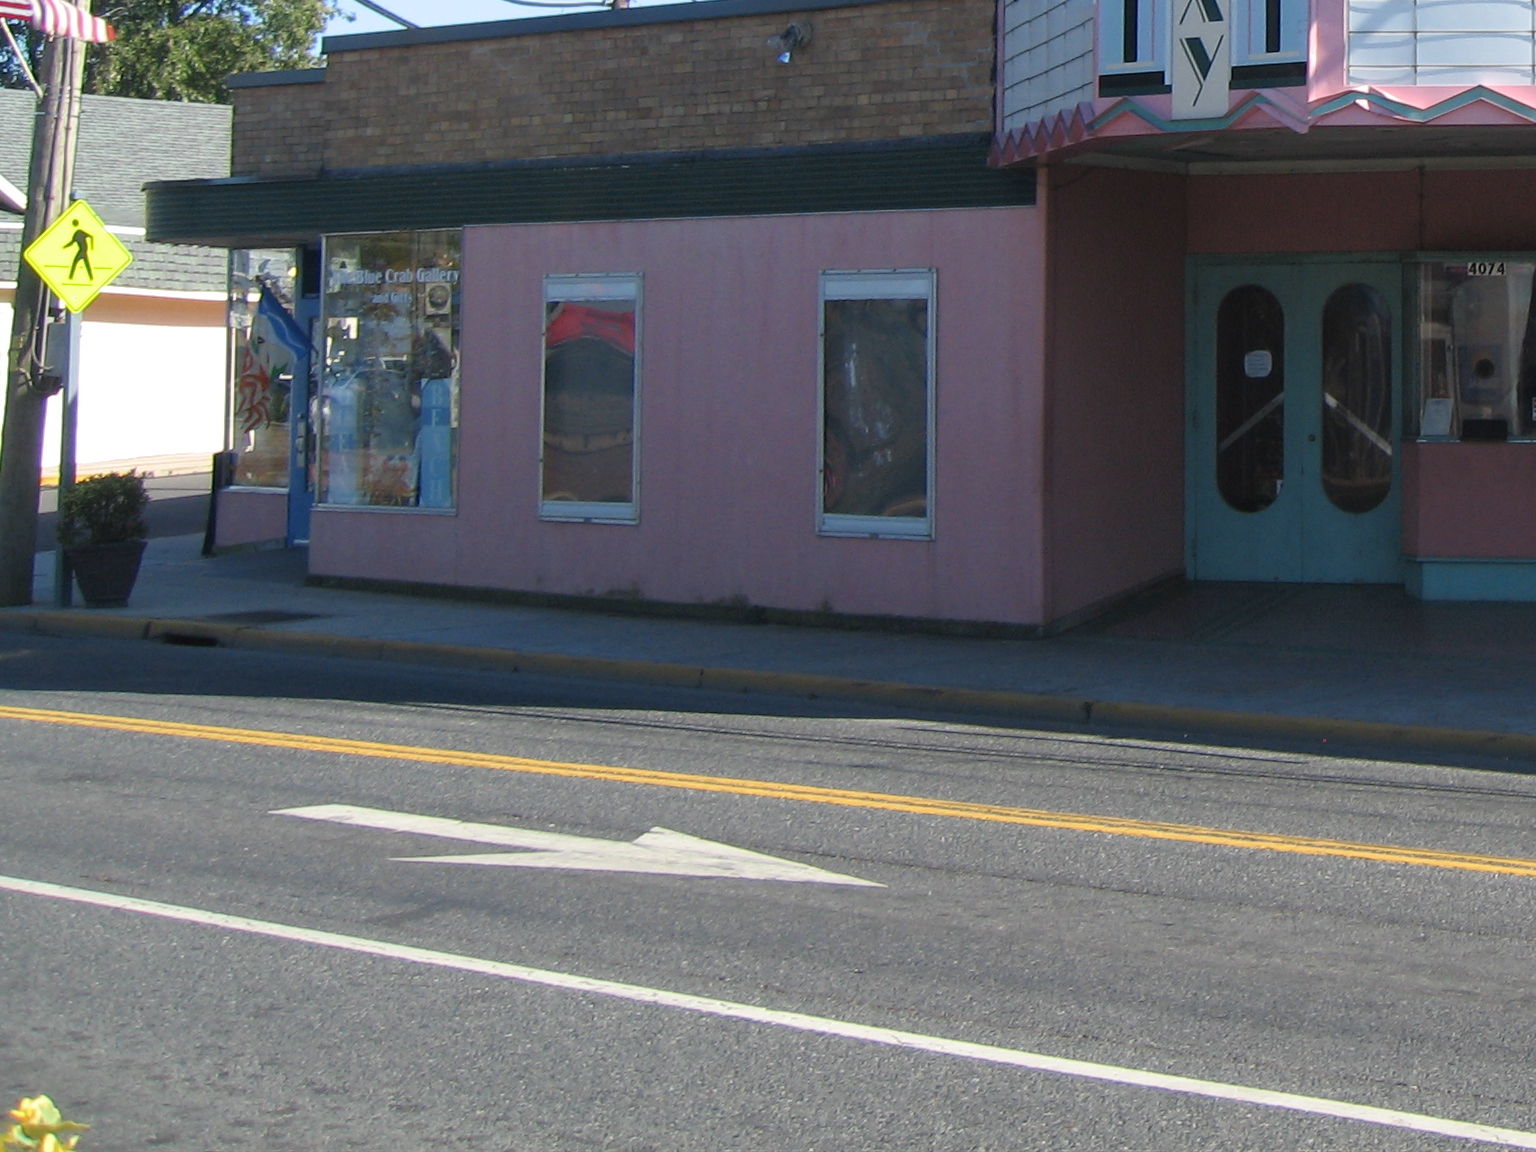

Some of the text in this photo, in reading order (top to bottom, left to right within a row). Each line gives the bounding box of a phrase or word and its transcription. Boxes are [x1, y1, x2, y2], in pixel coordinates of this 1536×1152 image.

[1468, 262, 1505, 275] 4074
[385, 268, 413, 283] Crab
[416, 268, 459, 285] Gallery
